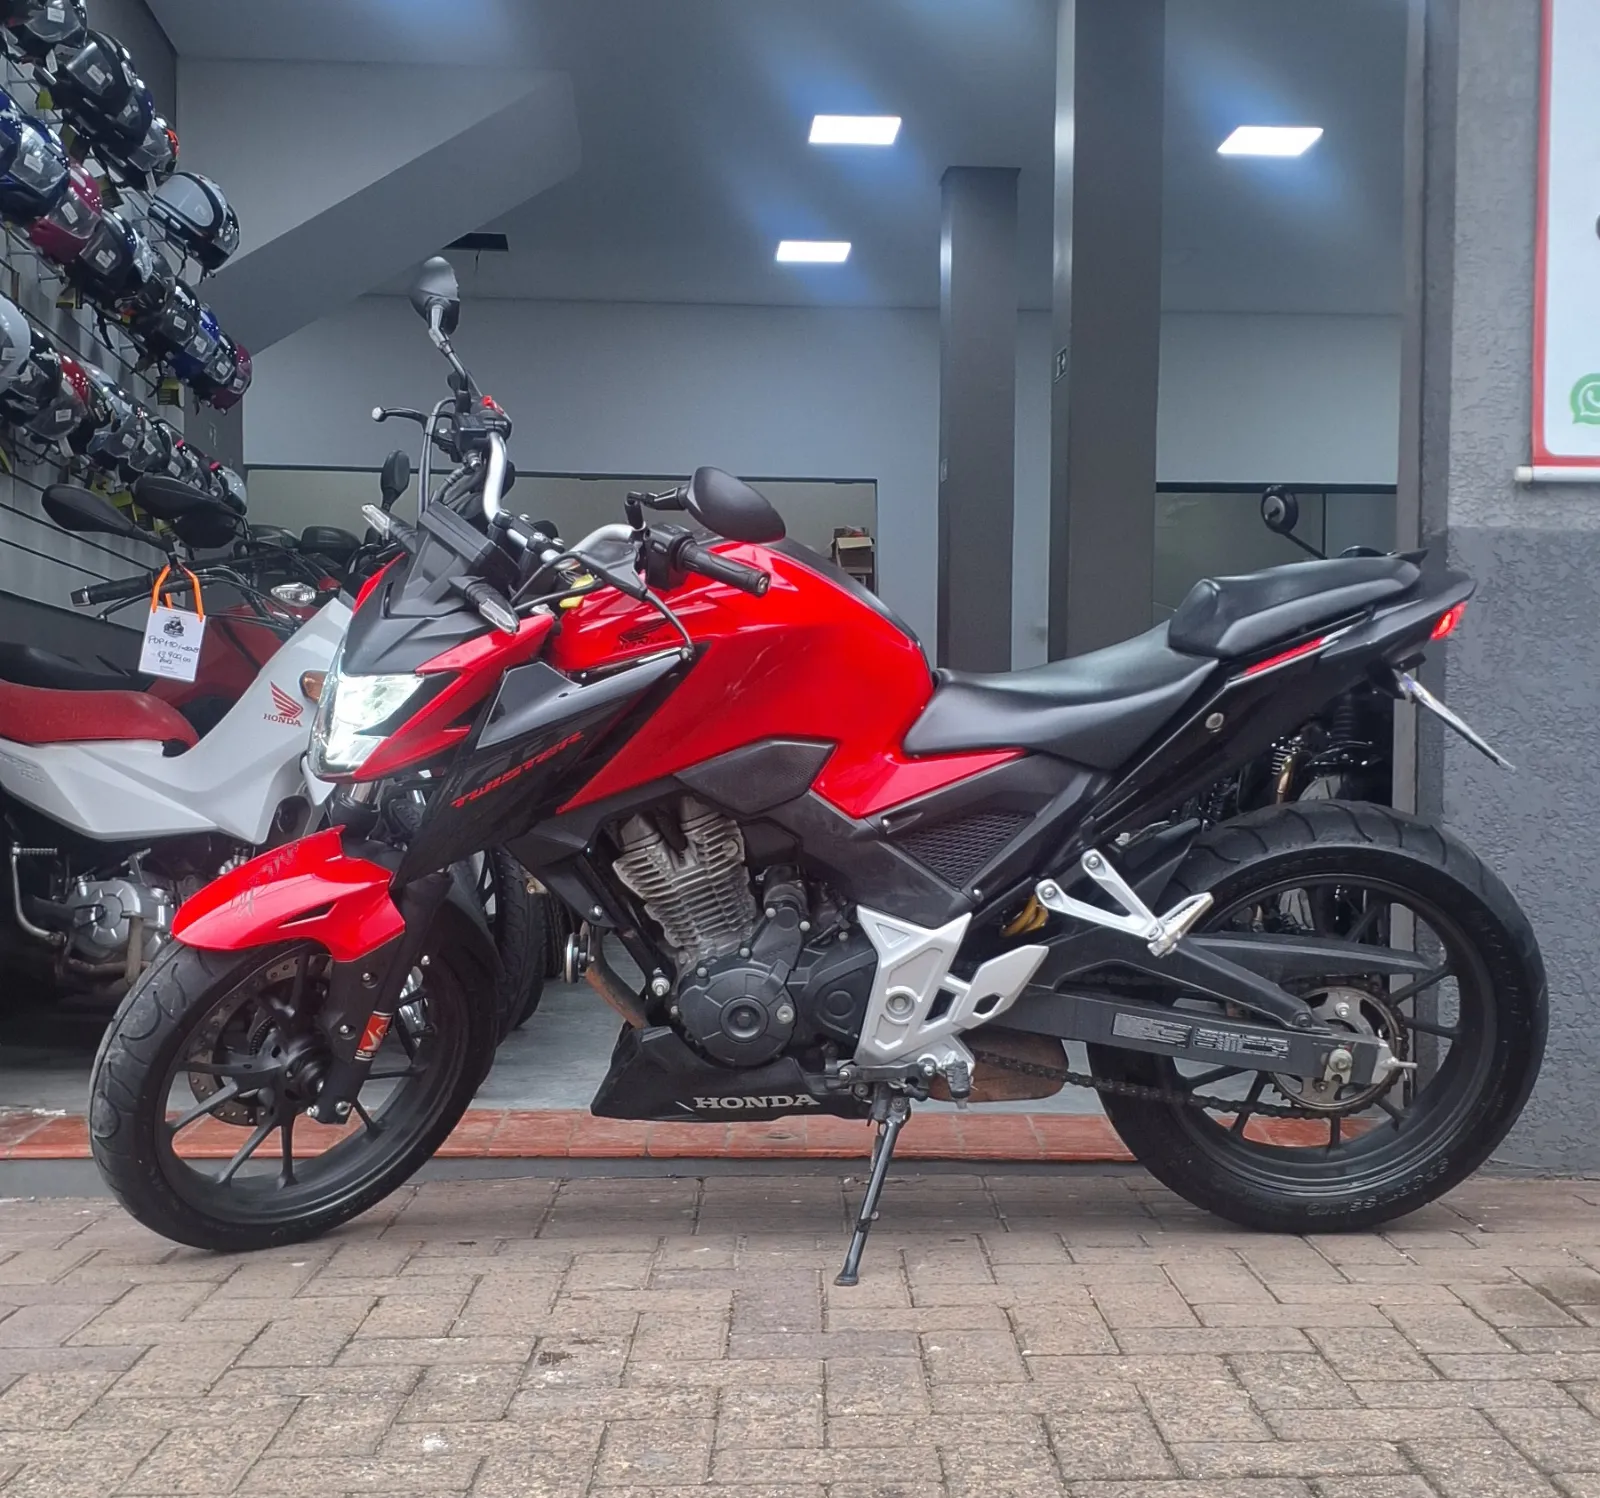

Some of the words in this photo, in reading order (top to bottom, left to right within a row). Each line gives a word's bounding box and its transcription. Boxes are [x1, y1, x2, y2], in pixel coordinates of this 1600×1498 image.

[263, 713, 302, 727] HONDA
[451, 731, 584, 808] TWISTER
[693, 1094, 821, 1109] HONDA
